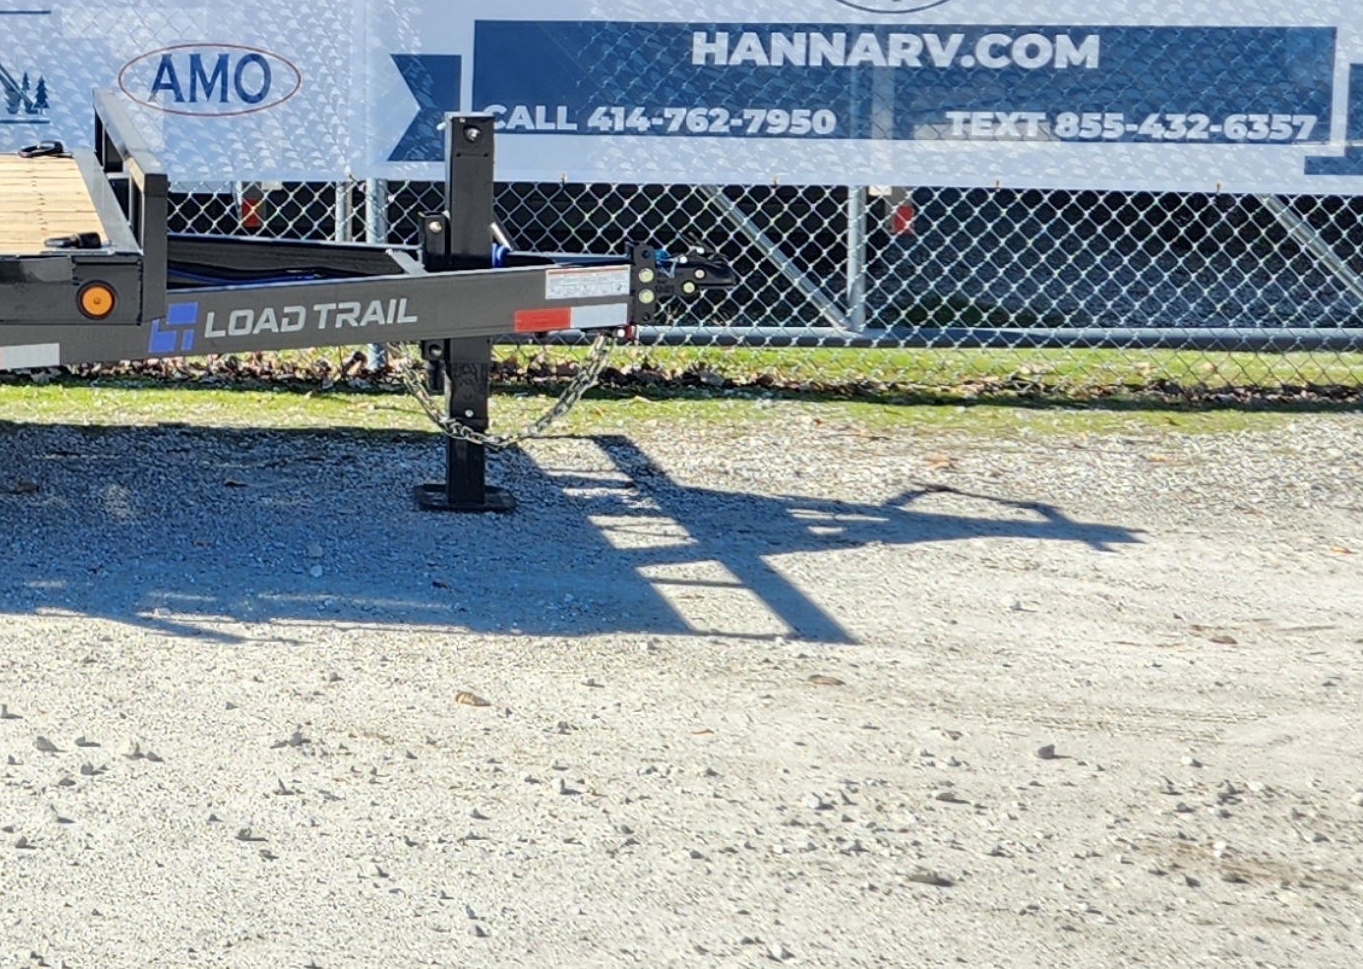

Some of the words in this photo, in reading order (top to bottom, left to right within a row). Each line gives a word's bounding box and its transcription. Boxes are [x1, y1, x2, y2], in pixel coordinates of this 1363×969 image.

[691, 31, 1101, 70] HANNARV.COM
[146, 52, 273, 105] AMO
[483, 104, 578, 131] CALL
[587, 106, 837, 136] 414-762-7950
[946, 111, 1047, 139] TEXT
[1054, 111, 1317, 141] 855-432-6357
[204, 304, 307, 339] LOAD
[313, 297, 419, 330] TRAIL
